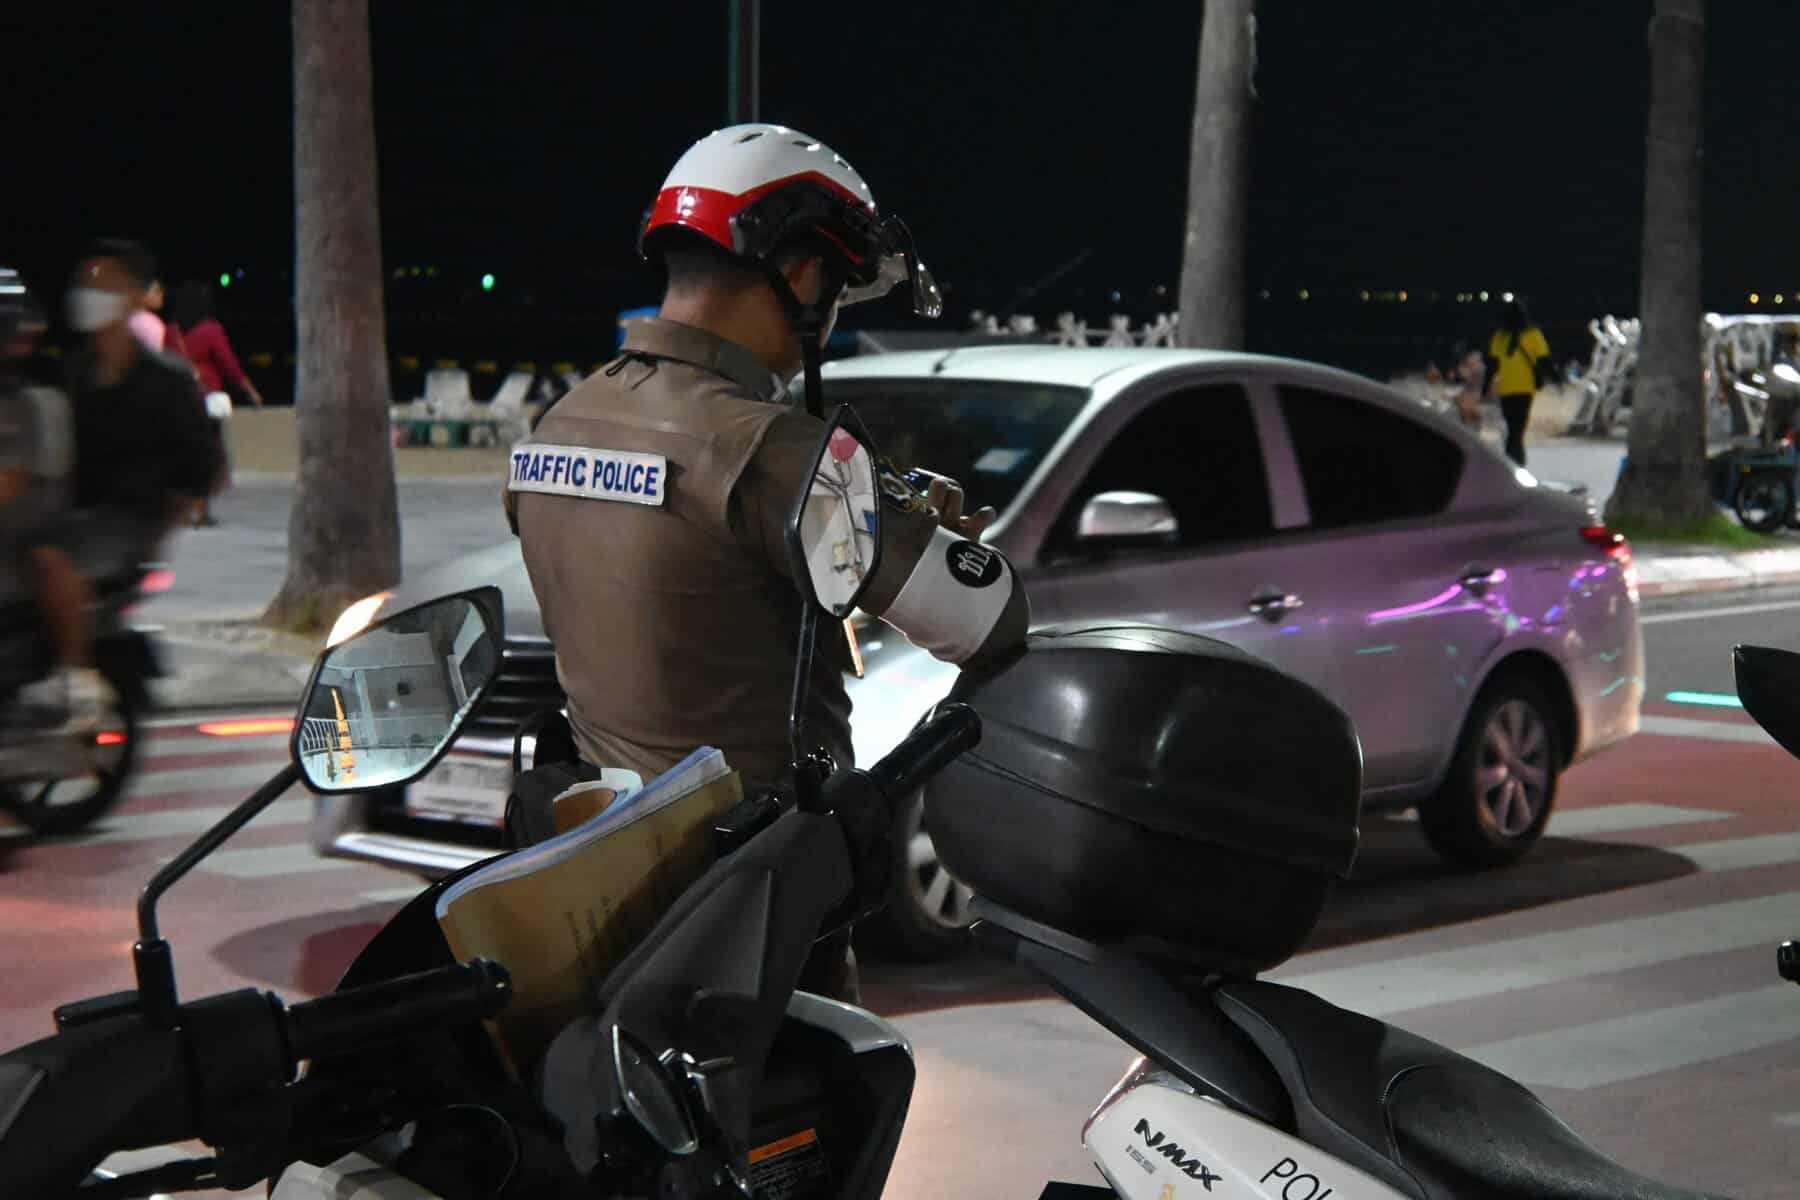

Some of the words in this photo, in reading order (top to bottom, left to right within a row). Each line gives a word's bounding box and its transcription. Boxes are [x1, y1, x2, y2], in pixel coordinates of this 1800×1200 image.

[513, 453, 587, 487] TRAFFIC
[592, 459, 659, 496] POLICE
[1134, 1118, 1223, 1192] NMAX
